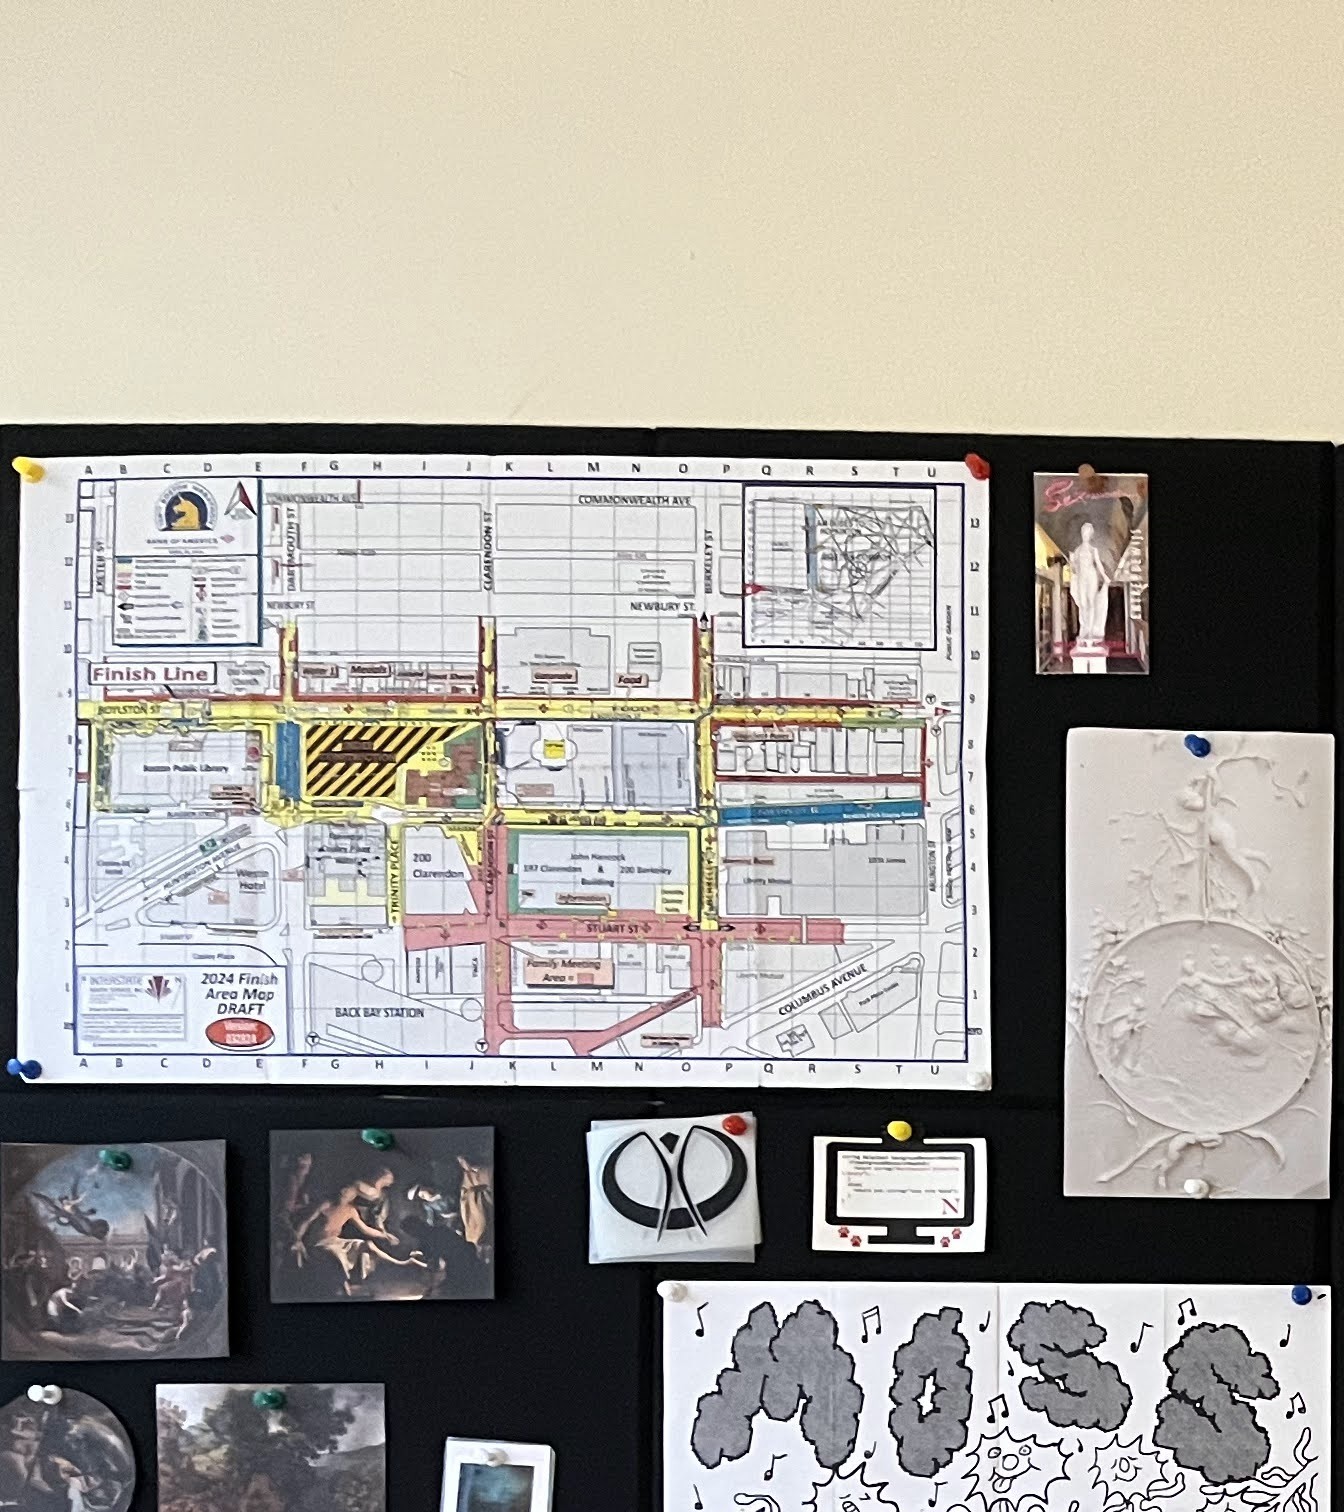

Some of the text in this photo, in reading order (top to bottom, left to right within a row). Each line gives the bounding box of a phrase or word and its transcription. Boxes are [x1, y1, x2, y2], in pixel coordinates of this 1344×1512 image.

[484, 528, 493, 591] CLARENDON
[630, 602, 678, 611] NEWBURY
[93, 666, 209, 682] Finish Line
[391, 839, 400, 913] TRINITY PLACE
[413, 868, 464, 879] Clarendon
[201, 972, 278, 985] 2024 Finish
[206, 988, 274, 1003] Area Map
[778, 963, 867, 1016] COLUMBUS AVENUE
[217, 1003, 264, 1015] DRAFT
[336, 1007, 424, 1018] BACK BAY STATION
